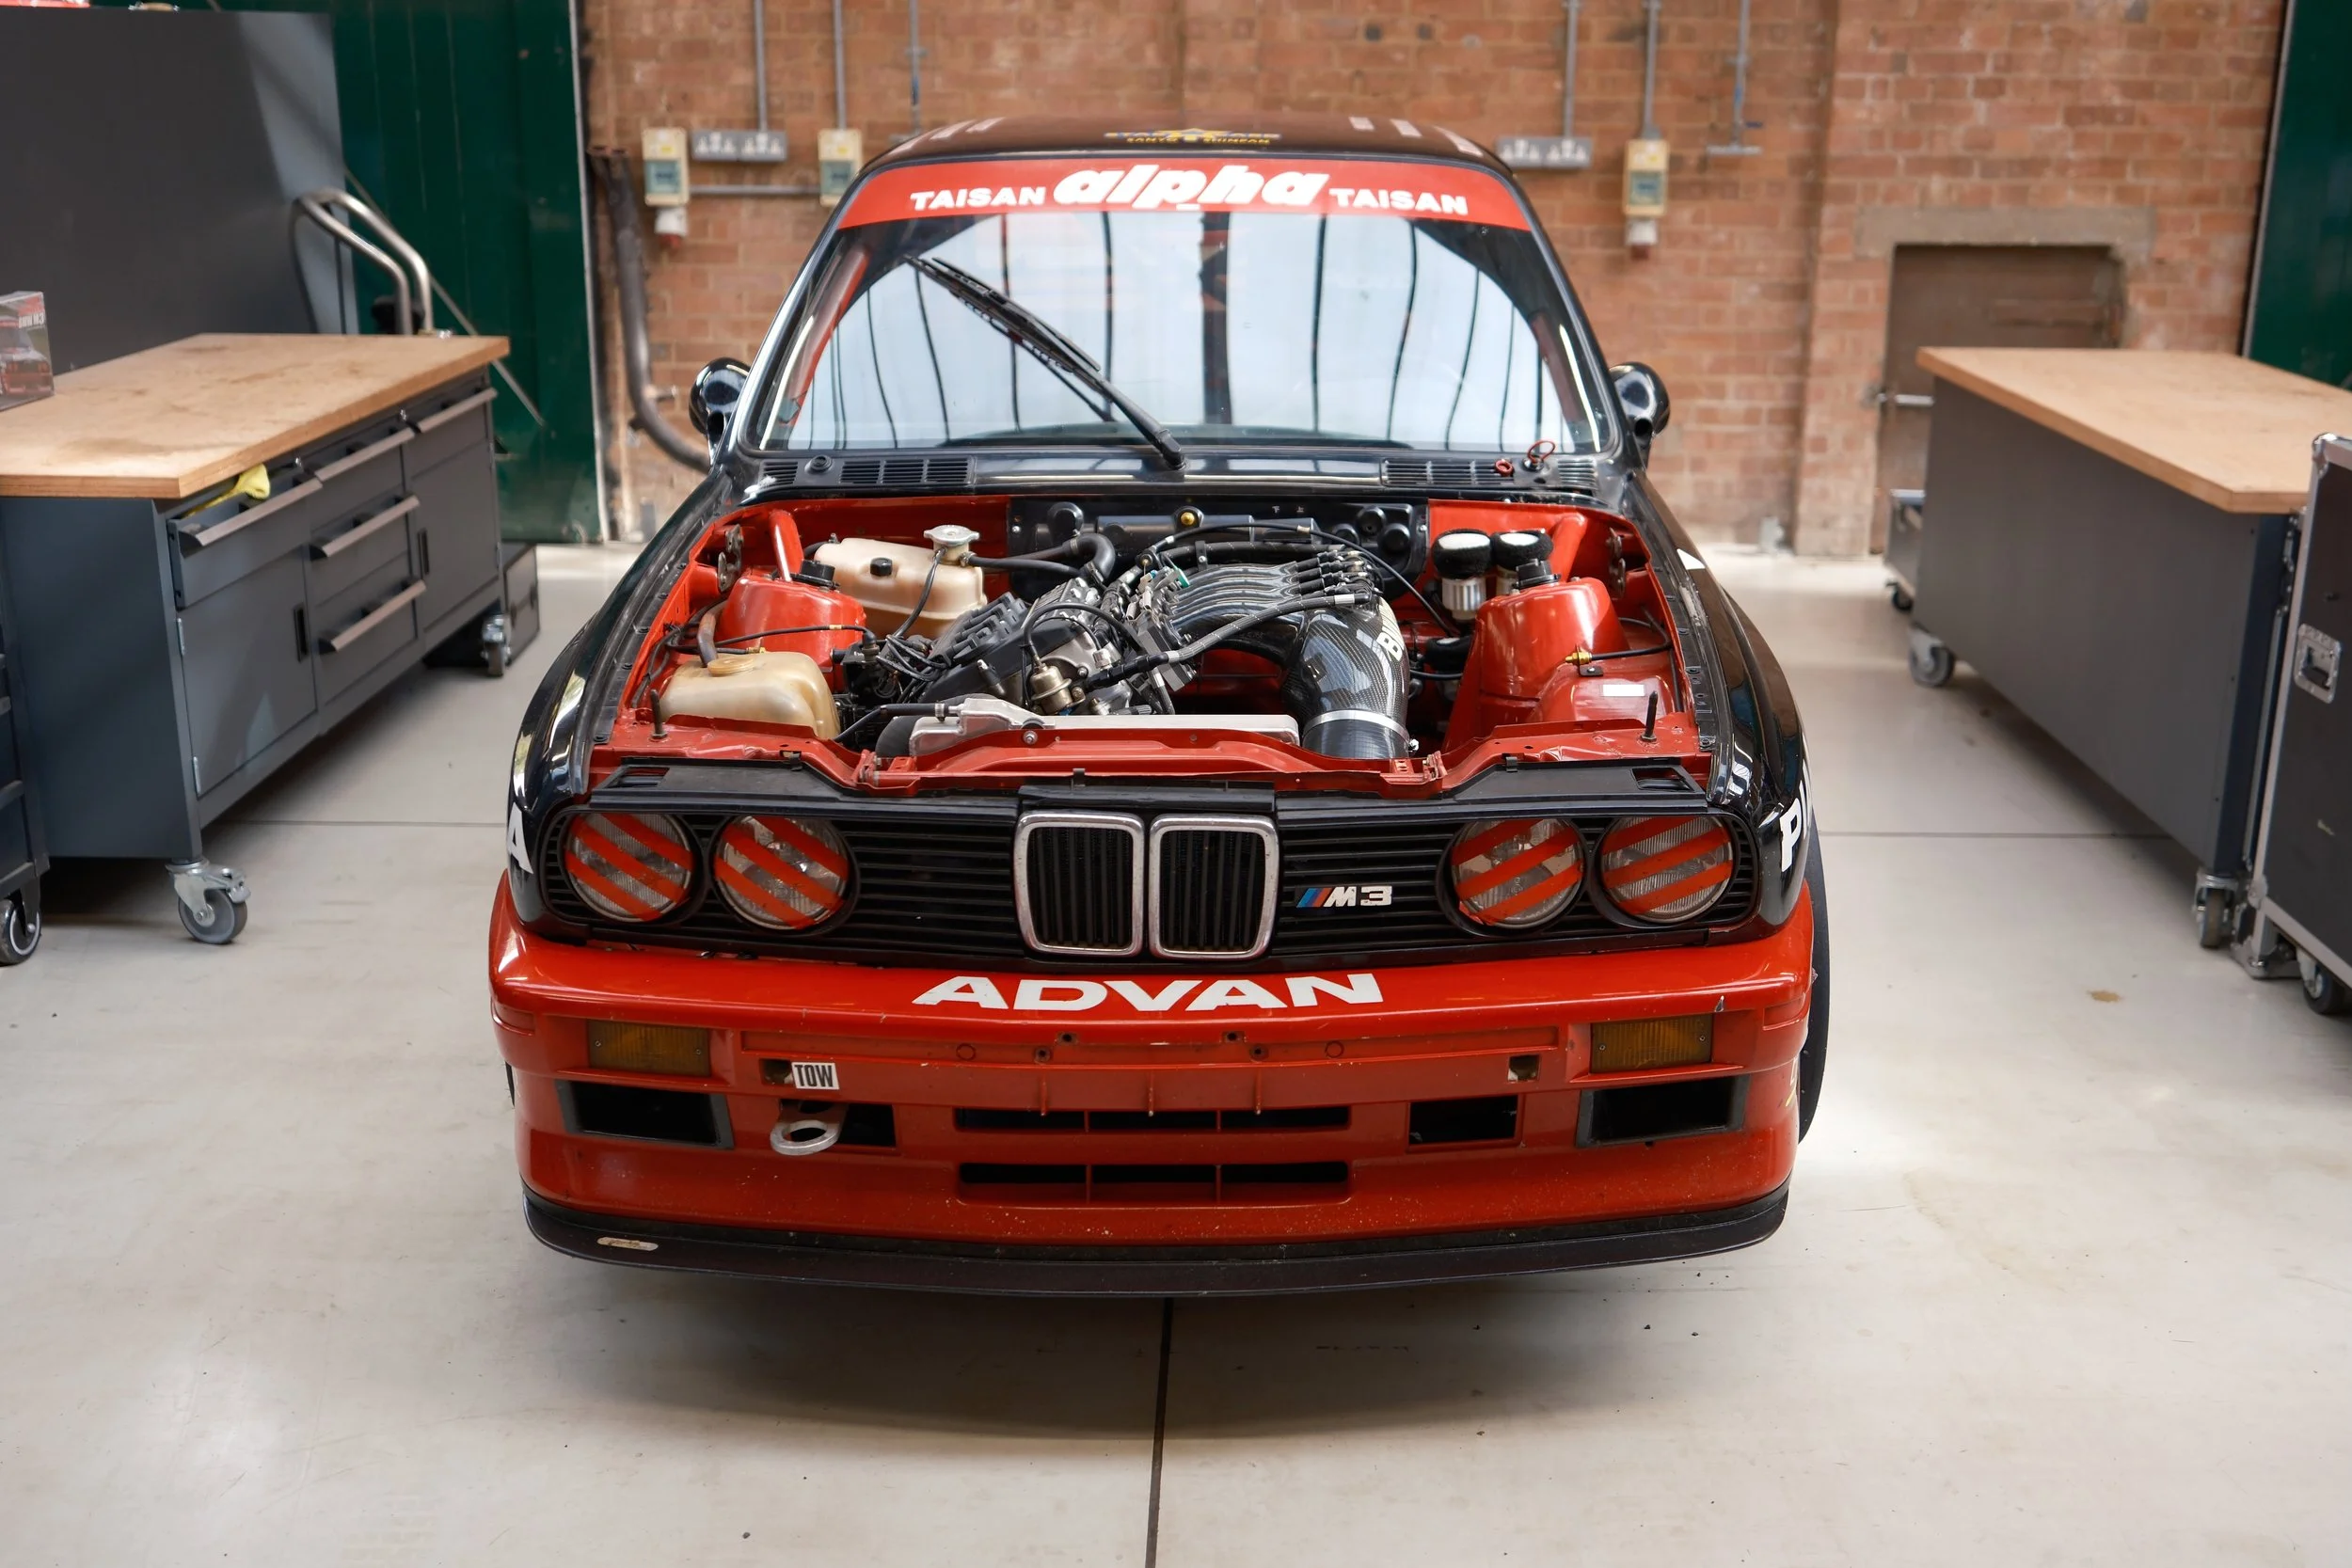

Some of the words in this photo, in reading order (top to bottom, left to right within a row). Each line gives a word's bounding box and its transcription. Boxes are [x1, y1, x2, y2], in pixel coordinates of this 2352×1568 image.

[910, 186, 1046, 211] TAISAN
[1053, 164, 1329, 210] alpha
[1328, 187, 1468, 215] TAISAN
[1322, 885, 1392, 908] M3
[912, 974, 1384, 1011] ADVAN
[794, 1064, 834, 1087] TOW
